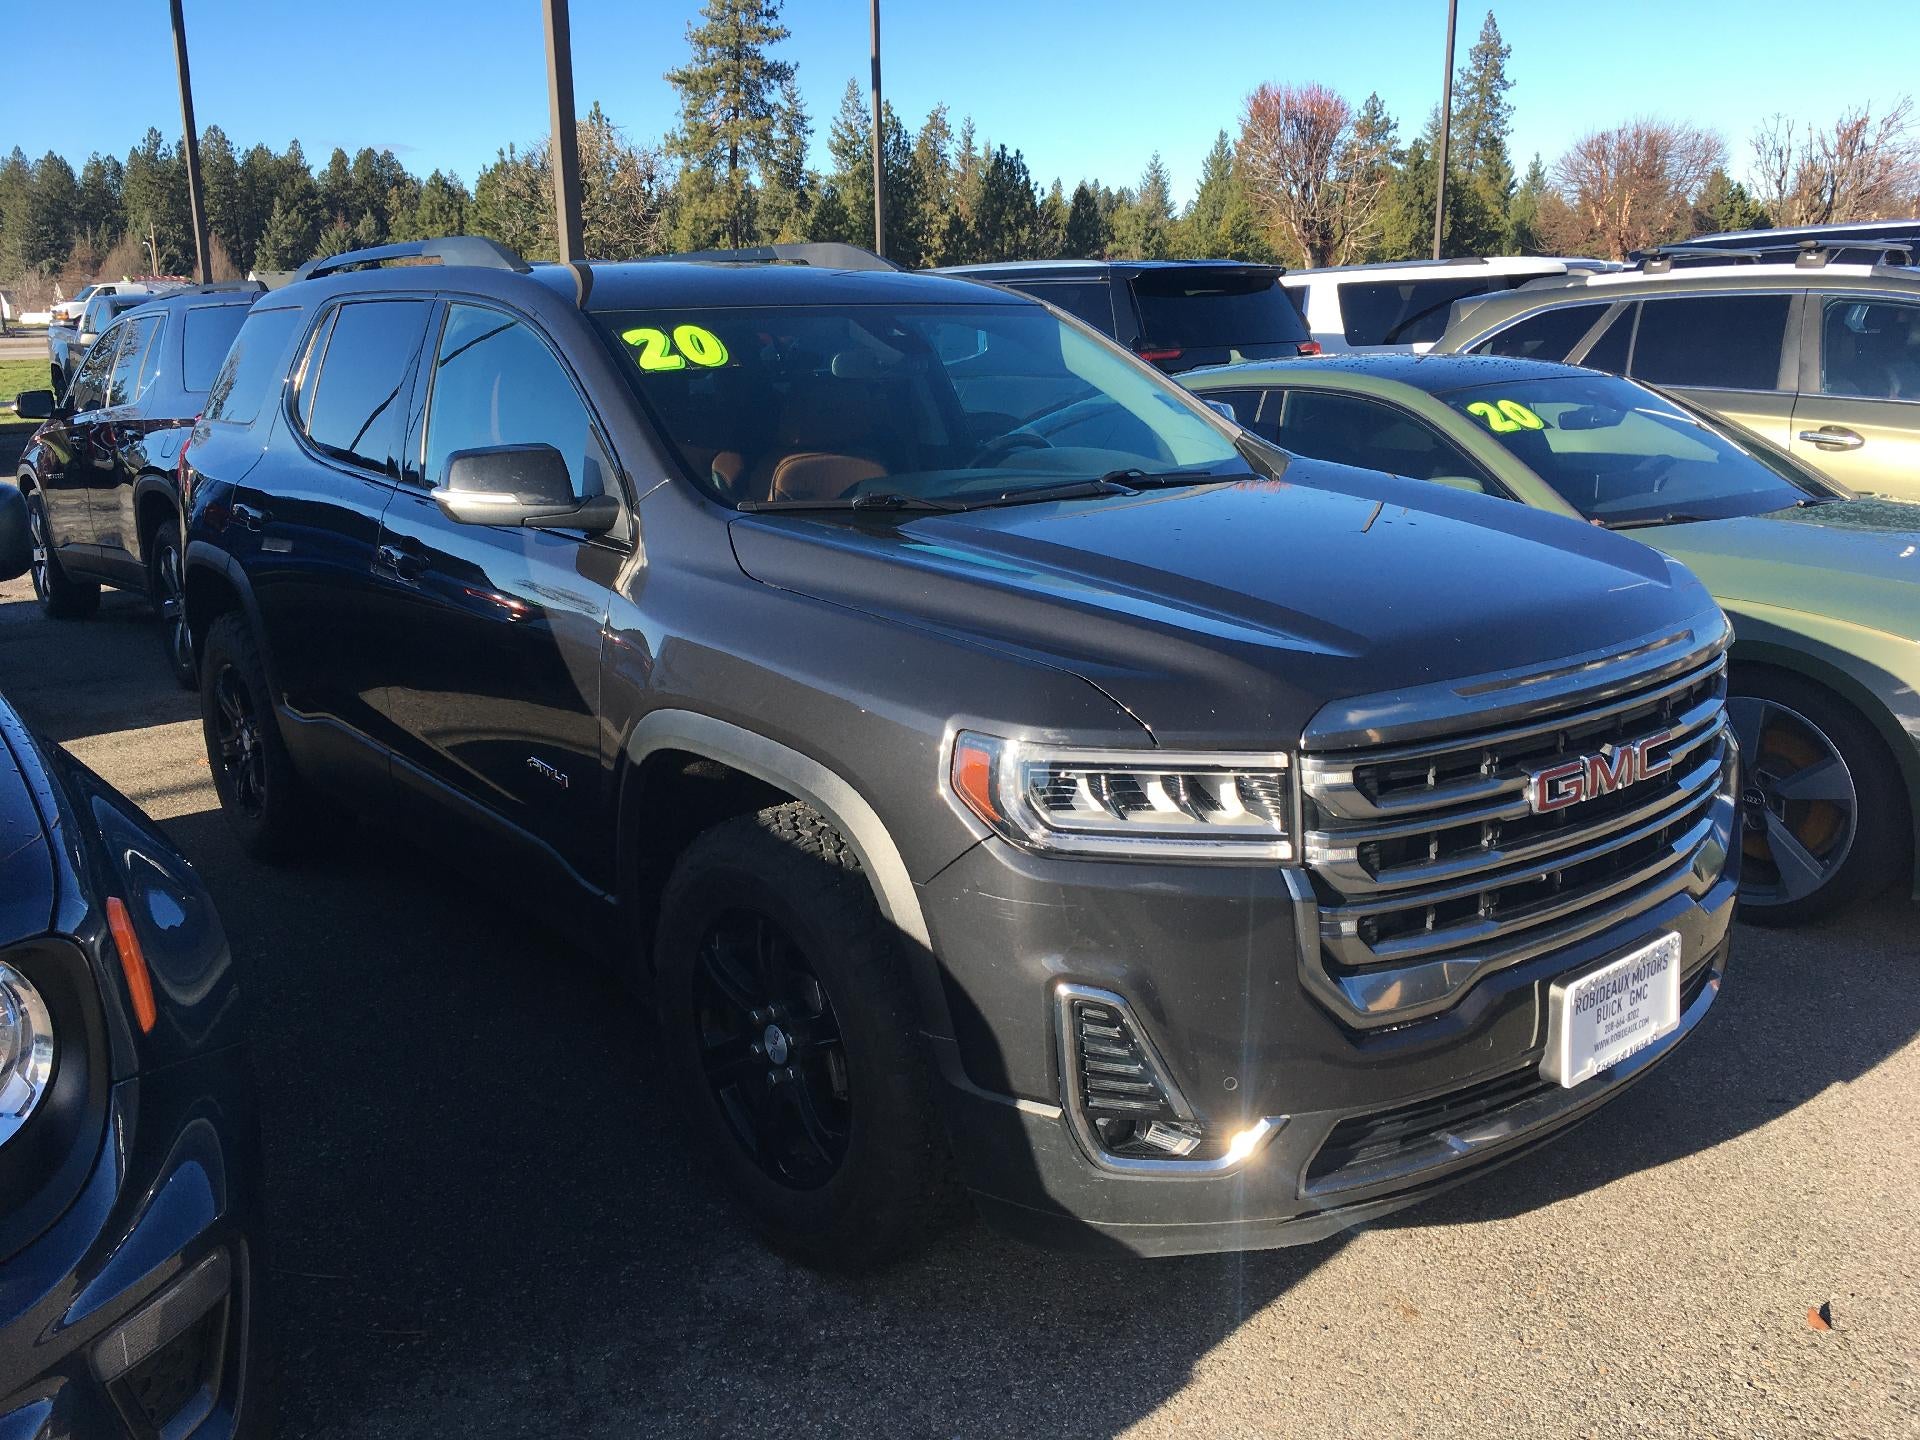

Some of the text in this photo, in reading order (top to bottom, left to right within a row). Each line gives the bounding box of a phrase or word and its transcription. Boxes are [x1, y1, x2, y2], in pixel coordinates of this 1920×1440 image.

[622, 325, 728, 371] 20
[1467, 399, 1544, 432] 20
[1530, 730, 1672, 813] GMC
[1576, 953, 1669, 1016] ROBIDEAUX MOTORS
[1596, 983, 1649, 1025] BUICK GMC
